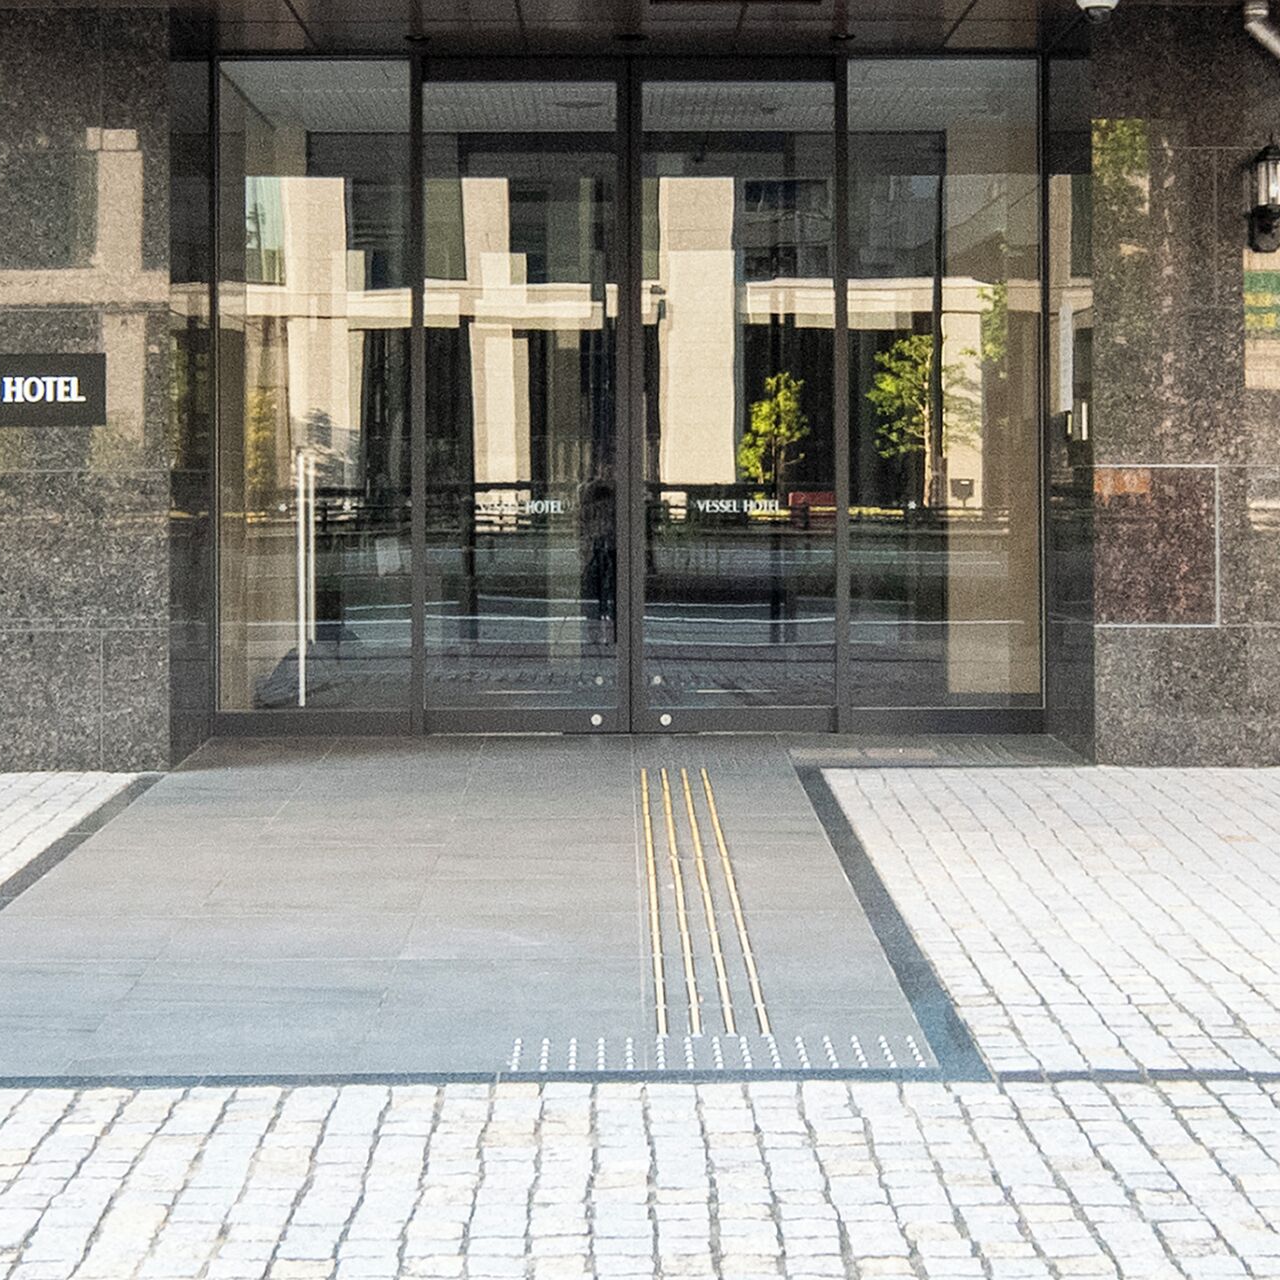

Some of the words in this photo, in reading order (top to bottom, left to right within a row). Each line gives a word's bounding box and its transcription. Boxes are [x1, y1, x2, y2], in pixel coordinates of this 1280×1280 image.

[2, 376, 87, 403] HOTEL
[526, 500, 565, 514] HOTEL
[696, 499, 740, 513] VESSEL
[743, 499, 782, 513] HOTEL
